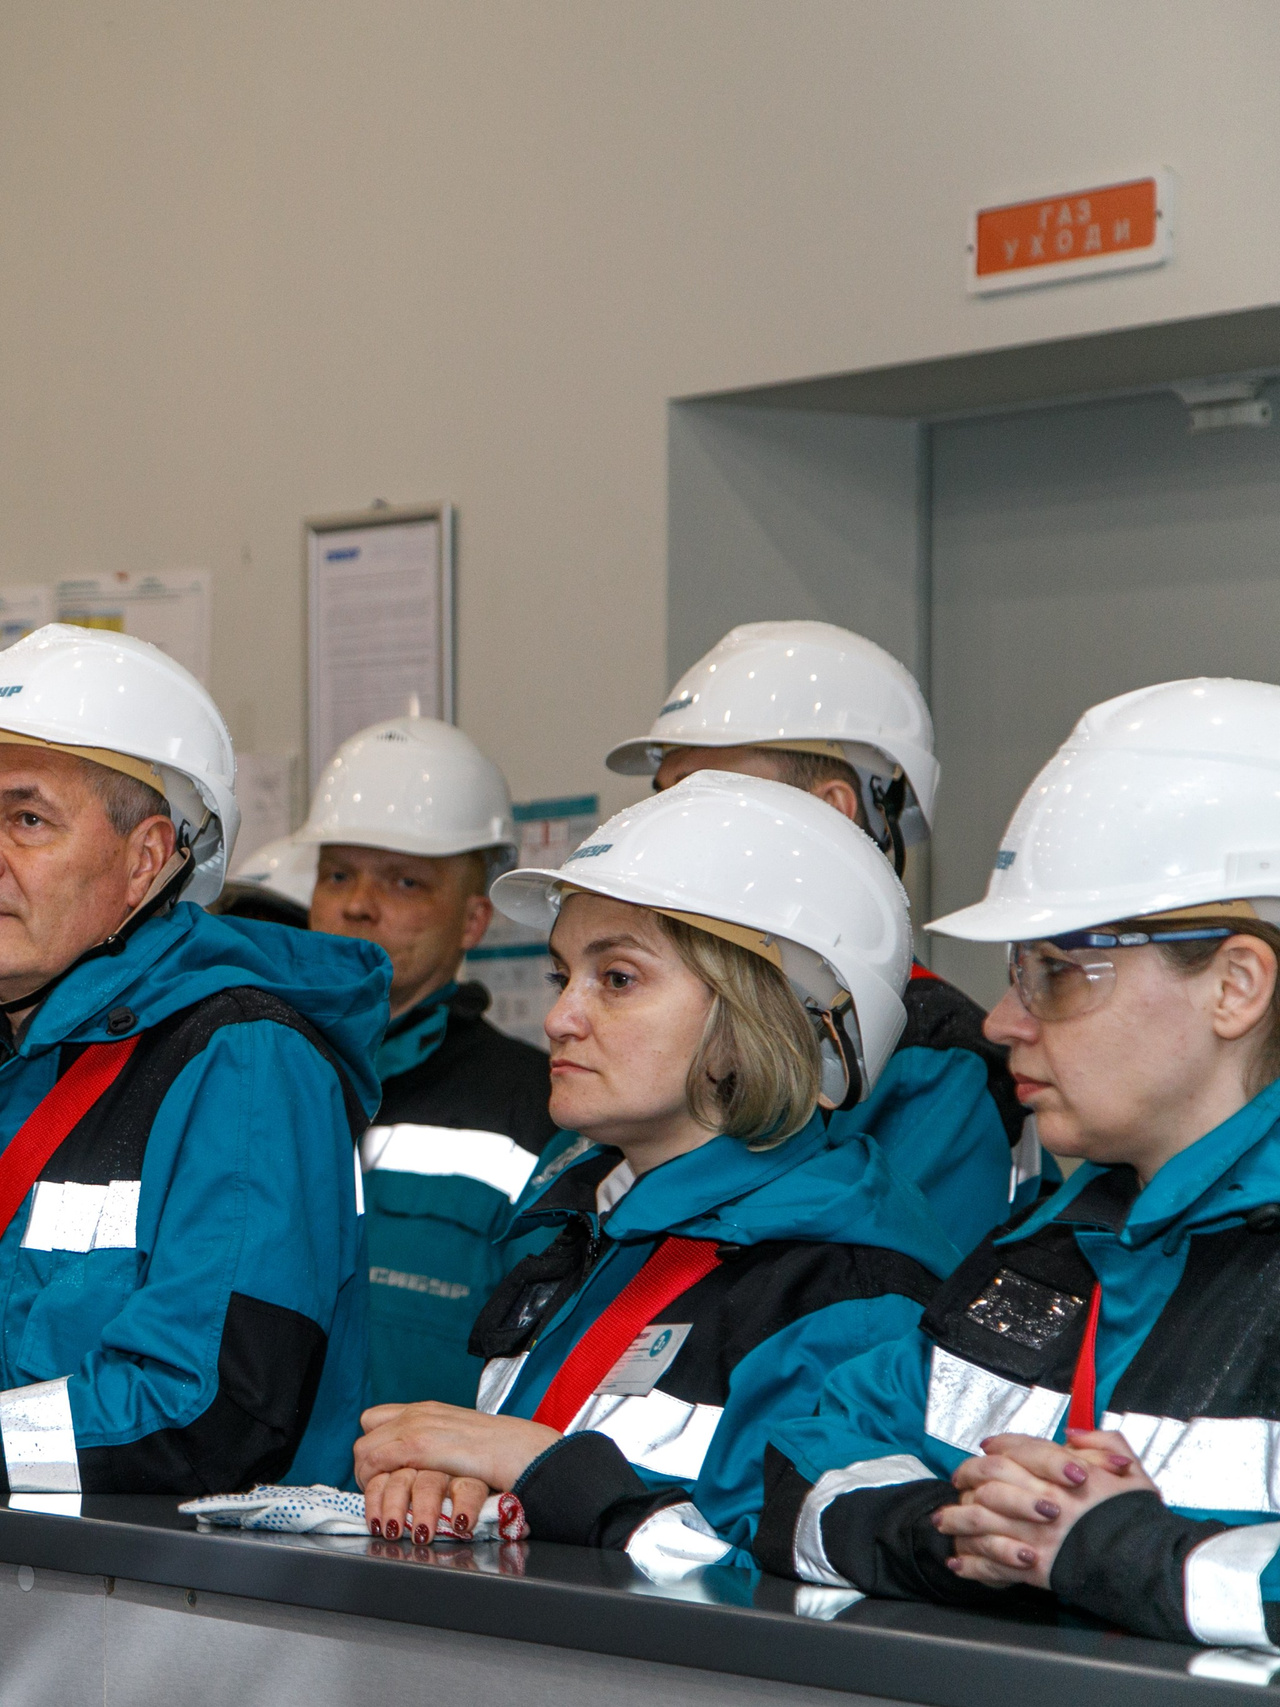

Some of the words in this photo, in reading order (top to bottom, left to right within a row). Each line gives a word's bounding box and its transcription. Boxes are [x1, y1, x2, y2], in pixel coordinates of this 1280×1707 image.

[1038, 198, 1092, 230] ГАЗ
[1003, 219, 1131, 263] УХОДИ
[369, 1266, 470, 1299] СИБУР
